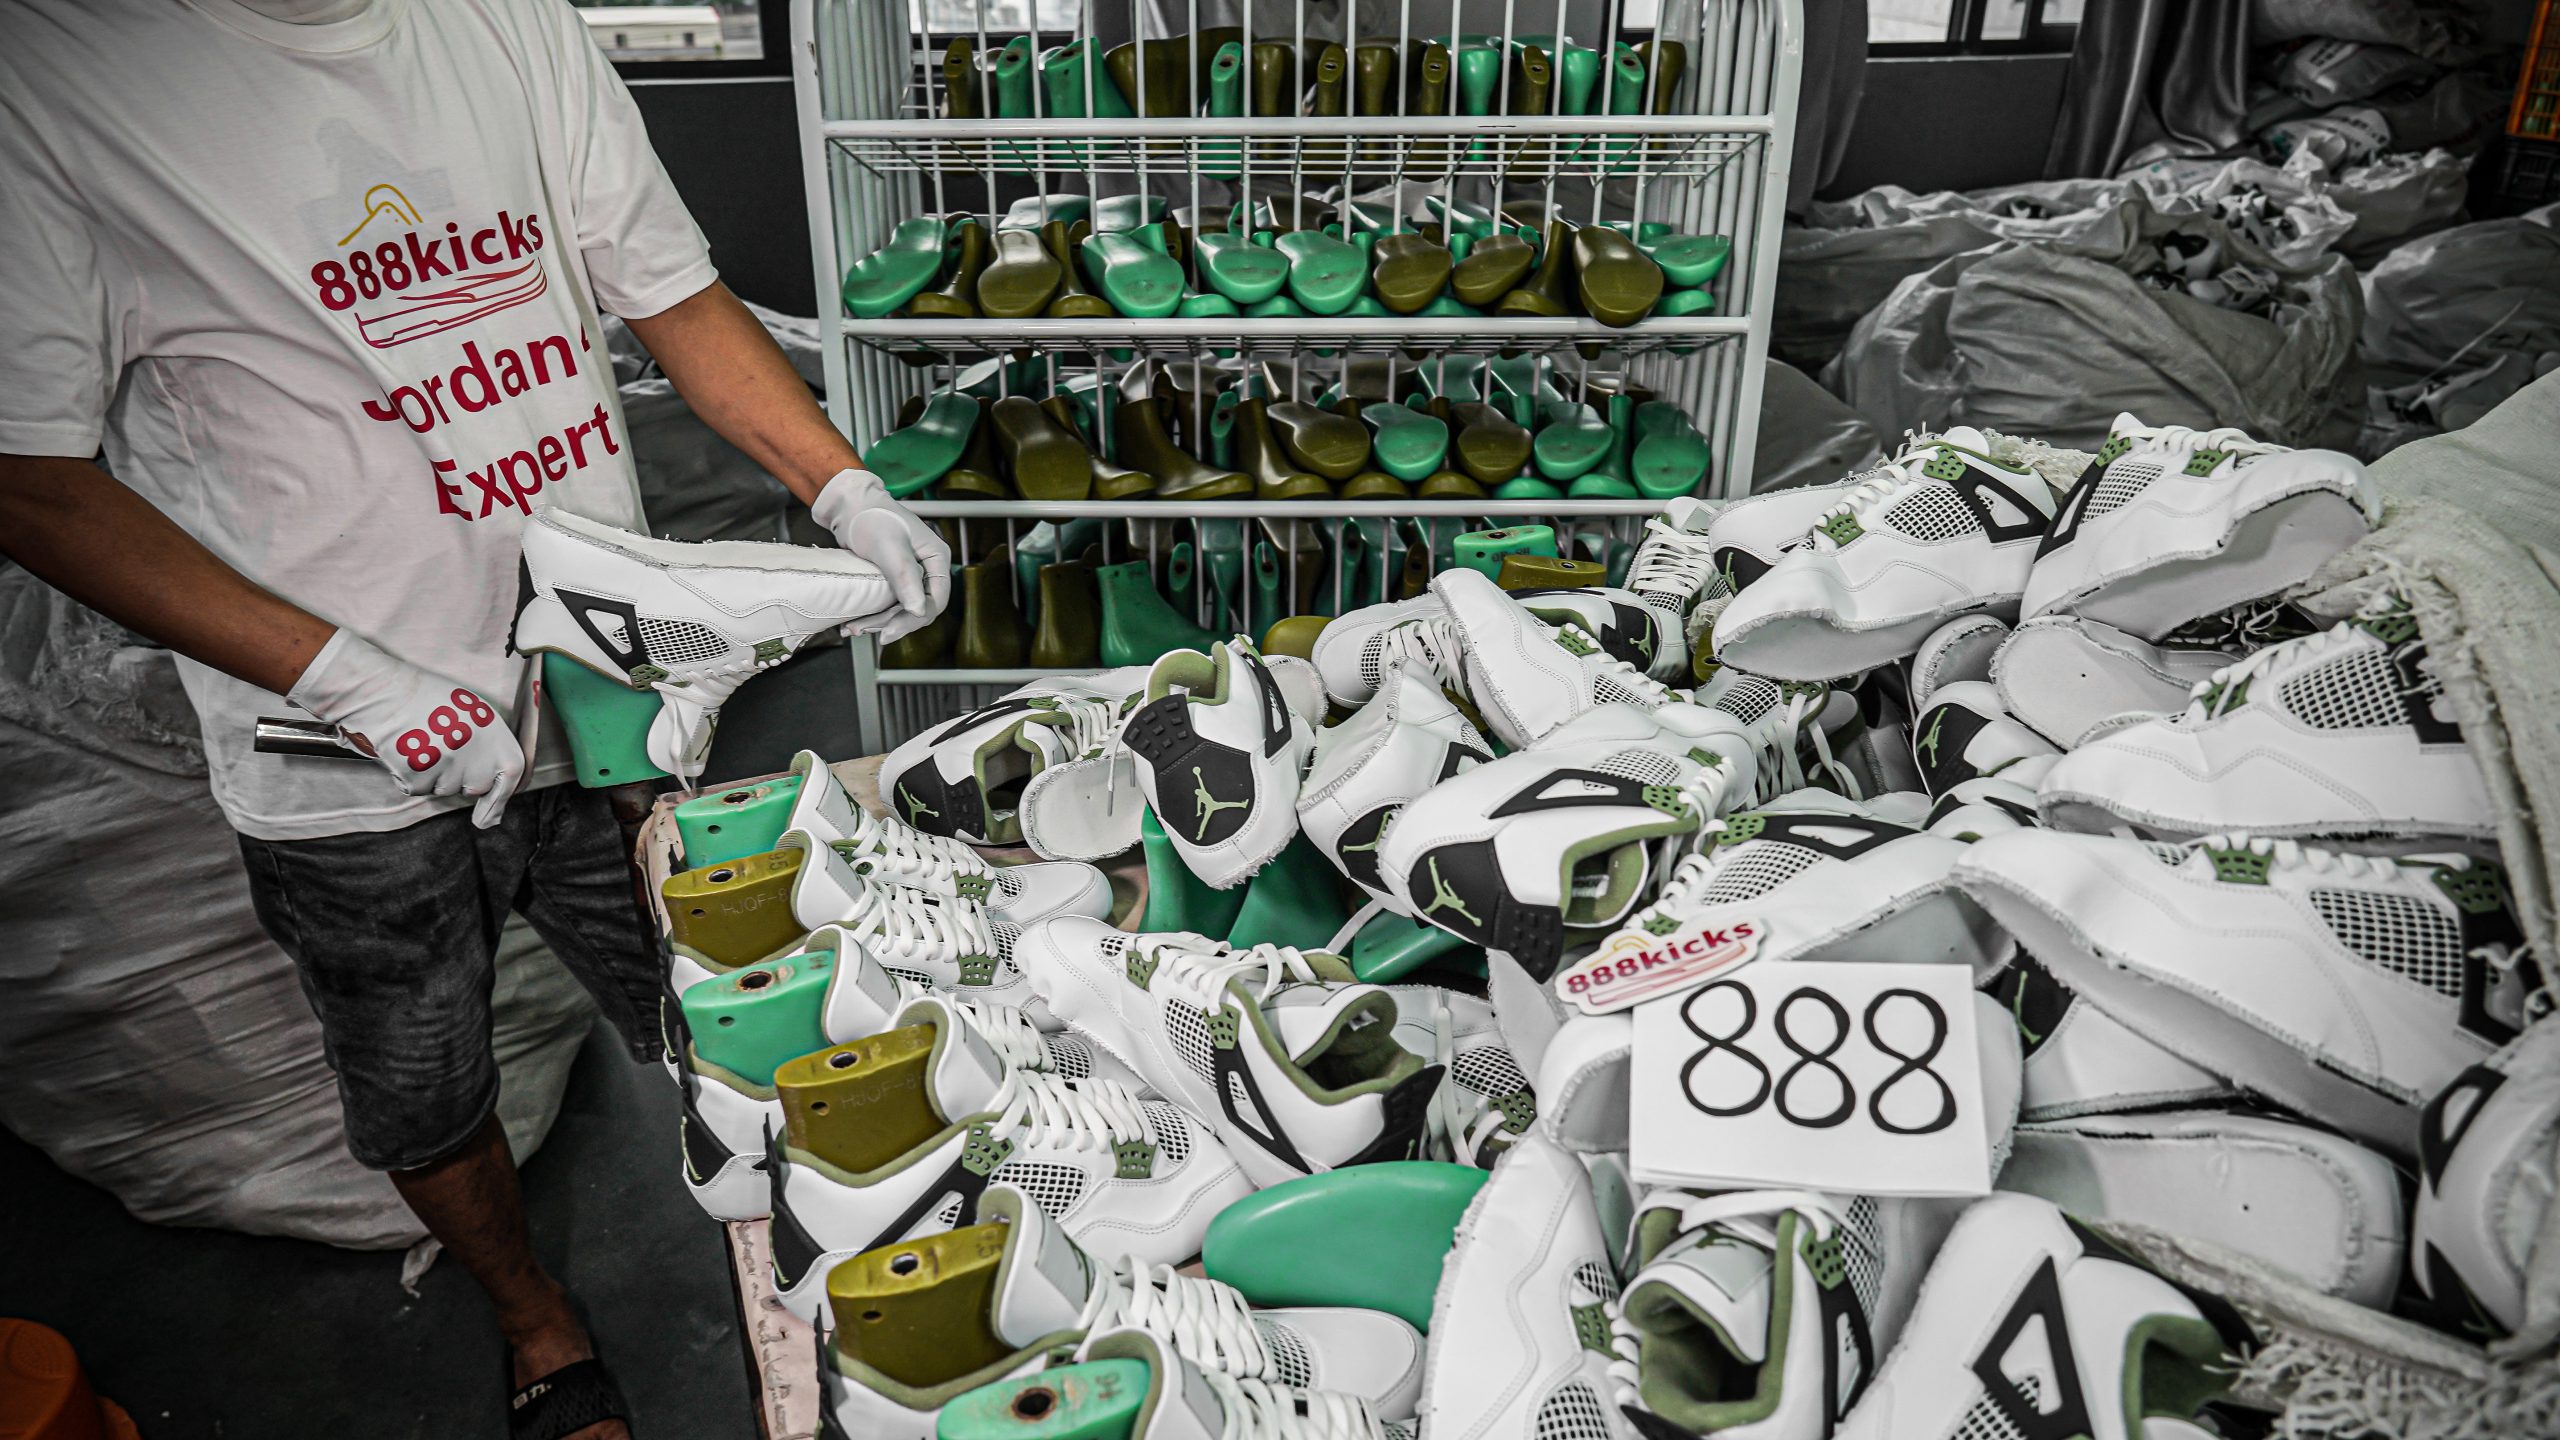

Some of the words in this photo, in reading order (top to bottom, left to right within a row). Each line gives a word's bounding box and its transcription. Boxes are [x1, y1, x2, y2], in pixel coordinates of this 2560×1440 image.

[310, 210, 544, 312] 888kicks
[430, 402, 619, 522] Expert
[395, 687, 495, 773] 888
[1566, 922, 1755, 994] 888kicks
[1679, 979, 1958, 1135] 888
